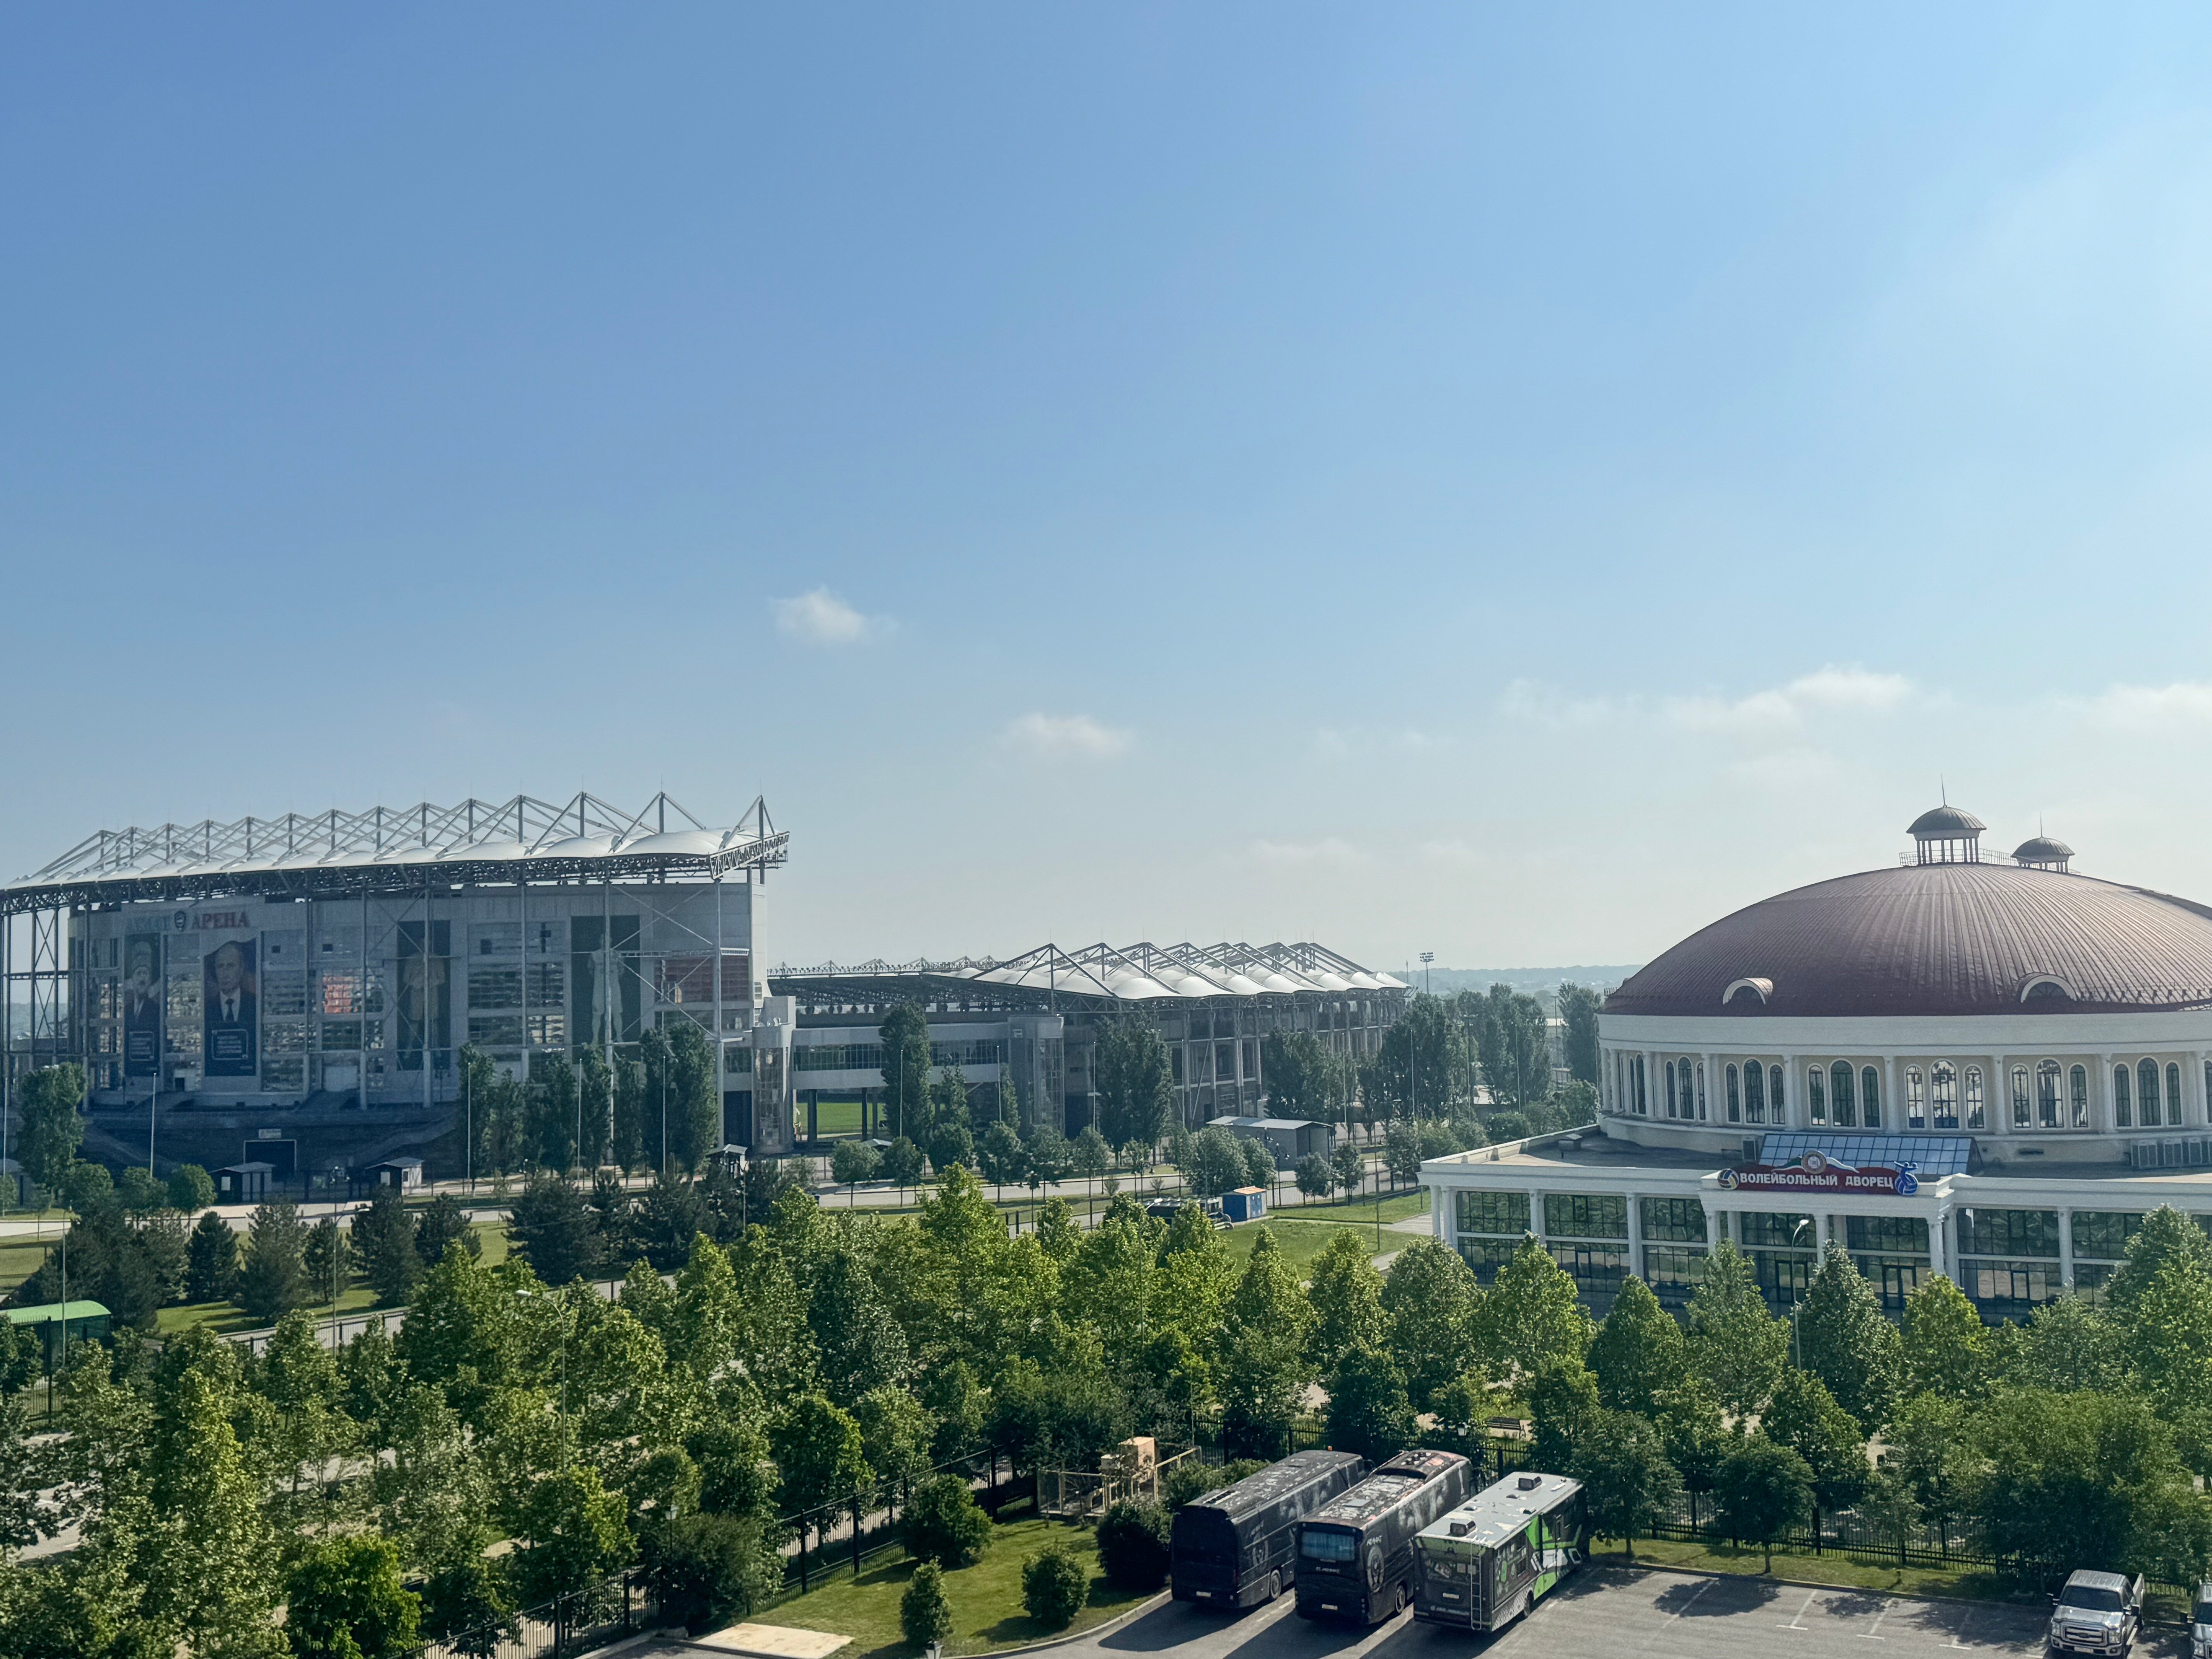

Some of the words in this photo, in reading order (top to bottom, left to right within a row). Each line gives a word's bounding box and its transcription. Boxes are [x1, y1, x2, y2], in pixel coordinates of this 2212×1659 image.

[192, 910, 250, 929] АРЕНА
[1740, 1172, 1838, 1186] ВОЛЕЙБОЛЬНЫЙ
[1845, 1175, 1894, 1189] ДВОРЕЦ
